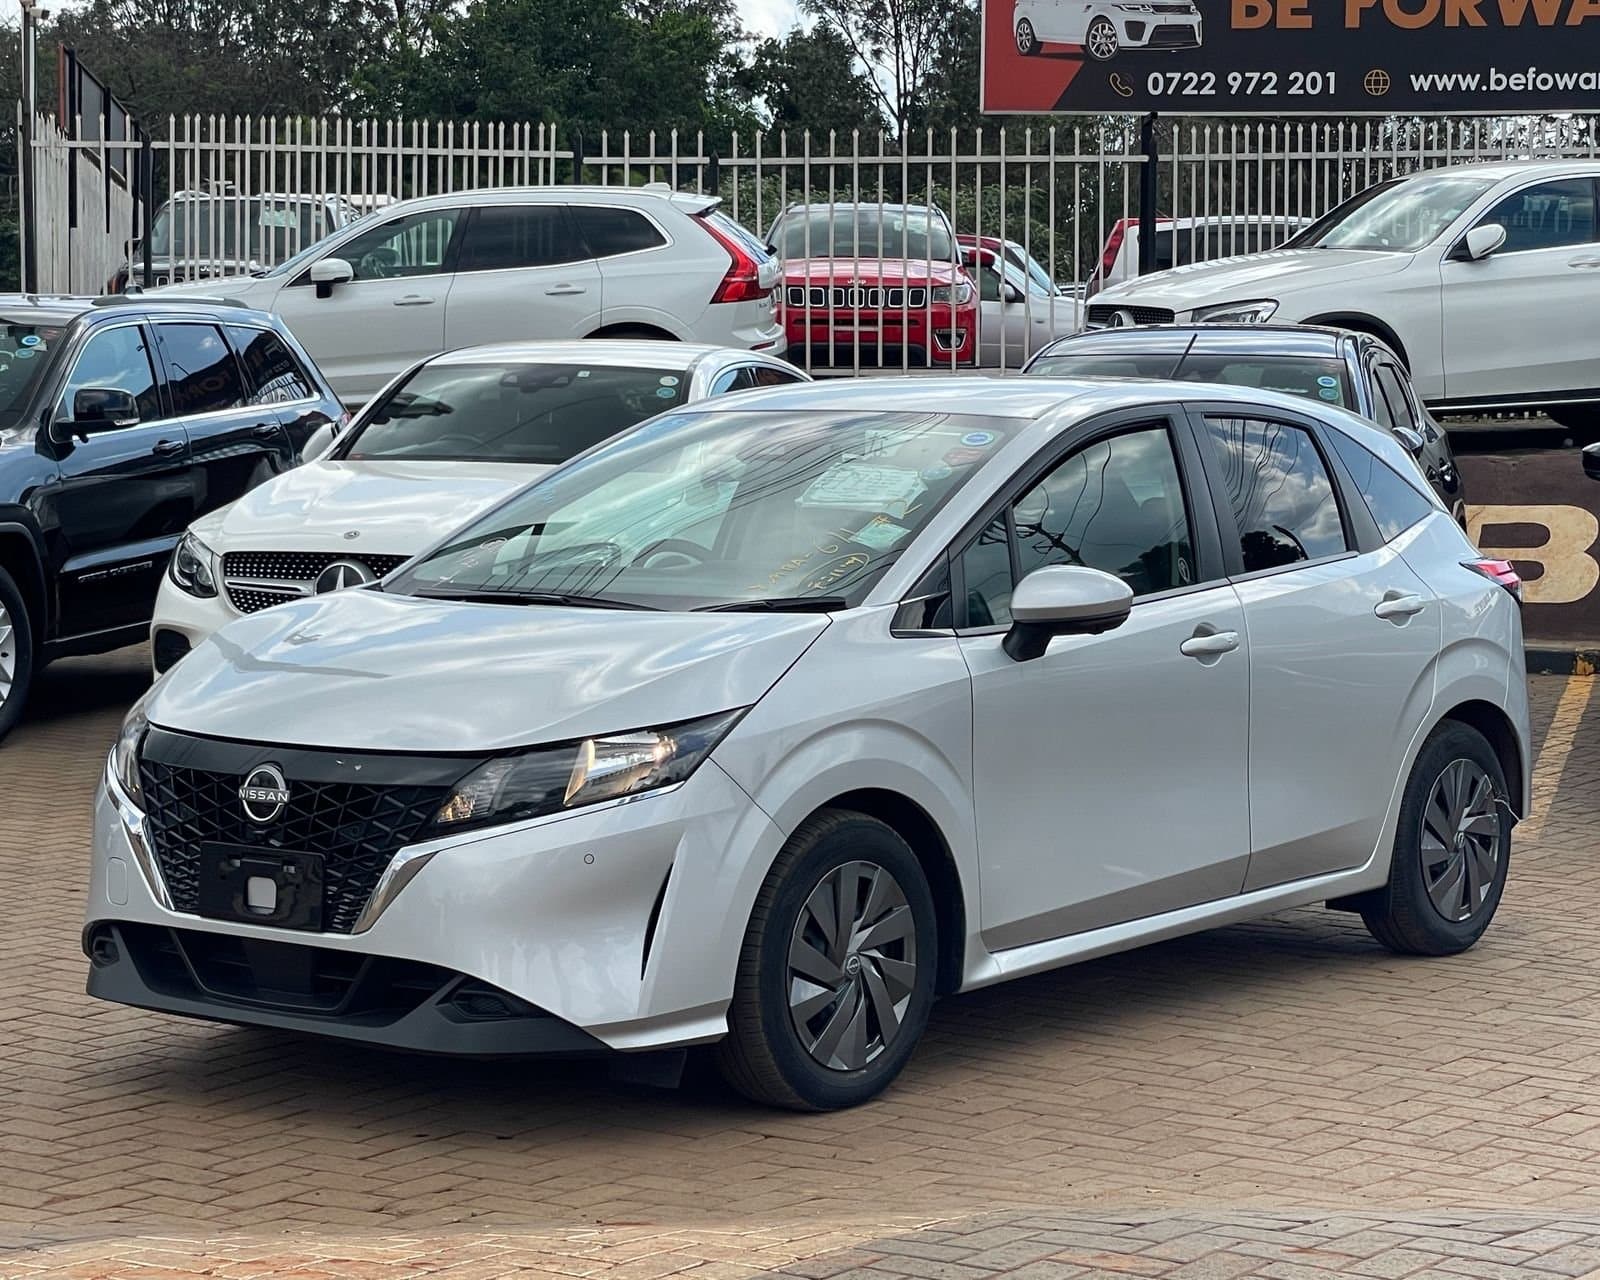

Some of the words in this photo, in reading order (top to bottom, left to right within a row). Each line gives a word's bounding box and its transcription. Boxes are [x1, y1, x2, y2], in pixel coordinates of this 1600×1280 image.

[1231, 0, 1313, 29] BE
[1147, 71, 1216, 96] 0722
[1227, 71, 1278, 96] 972
[1287, 71, 1336, 95] 201
[1409, 67, 1600, 92] www.befowa
[1464, 504, 1600, 604] B
[238, 788, 288, 802] NISSAN
